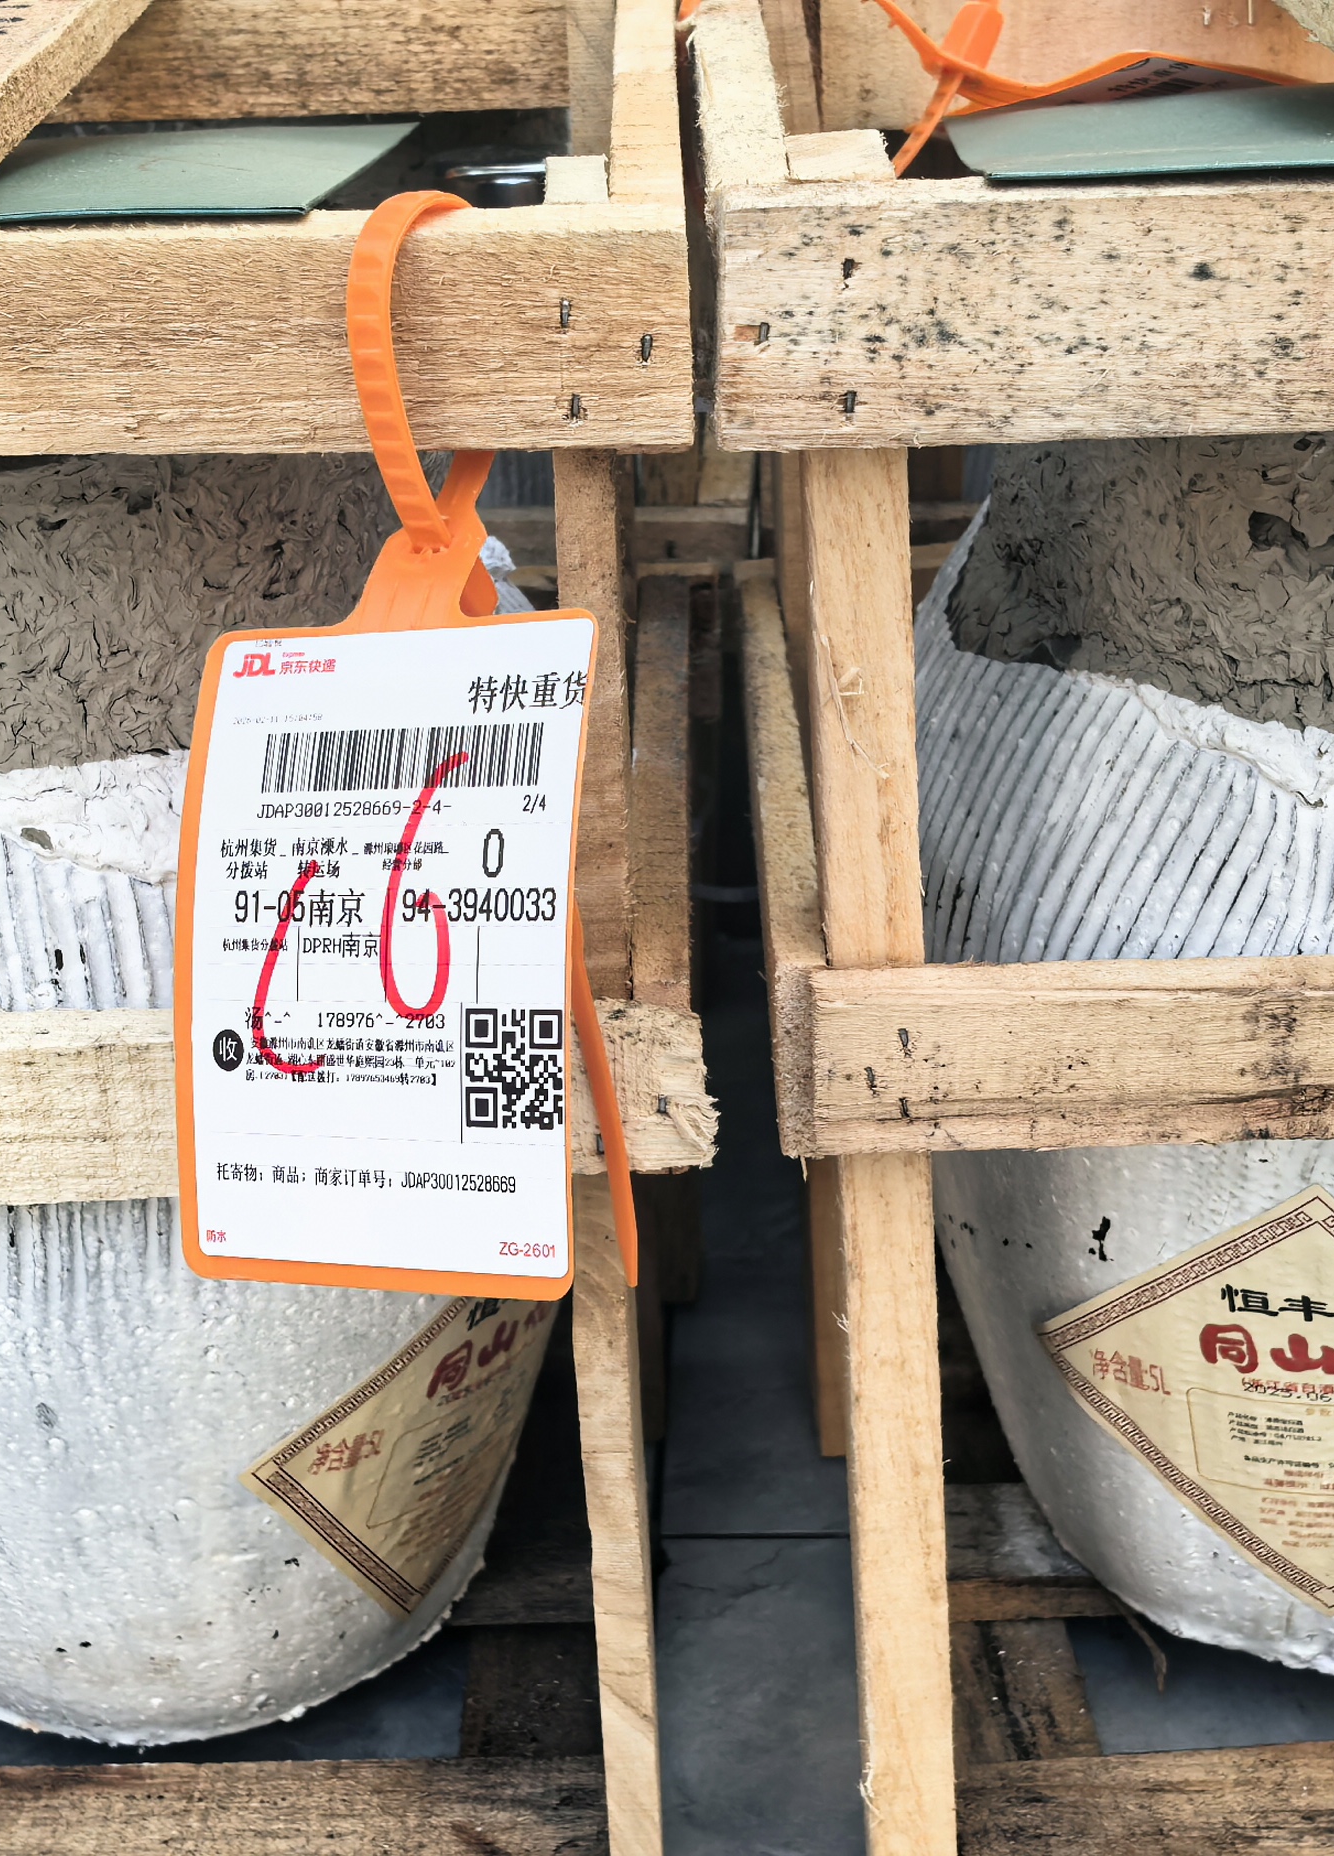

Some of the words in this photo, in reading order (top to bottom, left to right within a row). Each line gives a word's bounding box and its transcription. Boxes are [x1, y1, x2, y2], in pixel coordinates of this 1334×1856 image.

[233, 652, 276, 678] JDL
[279, 659, 337, 675] 京东快递
[468, 670, 587, 714] 特快重货
[523, 794, 547, 814] 2/4
[482, 828, 505, 878] 0
[226, 860, 268, 880] 分拨站
[402, 887, 557, 923] 94-3940033
[303, 931, 382, 959] DPRH南京
[219, 1036, 238, 1062] 收
[206, 1229, 227, 1243] 防水
[499, 1241, 556, 1258] ZG-2601
